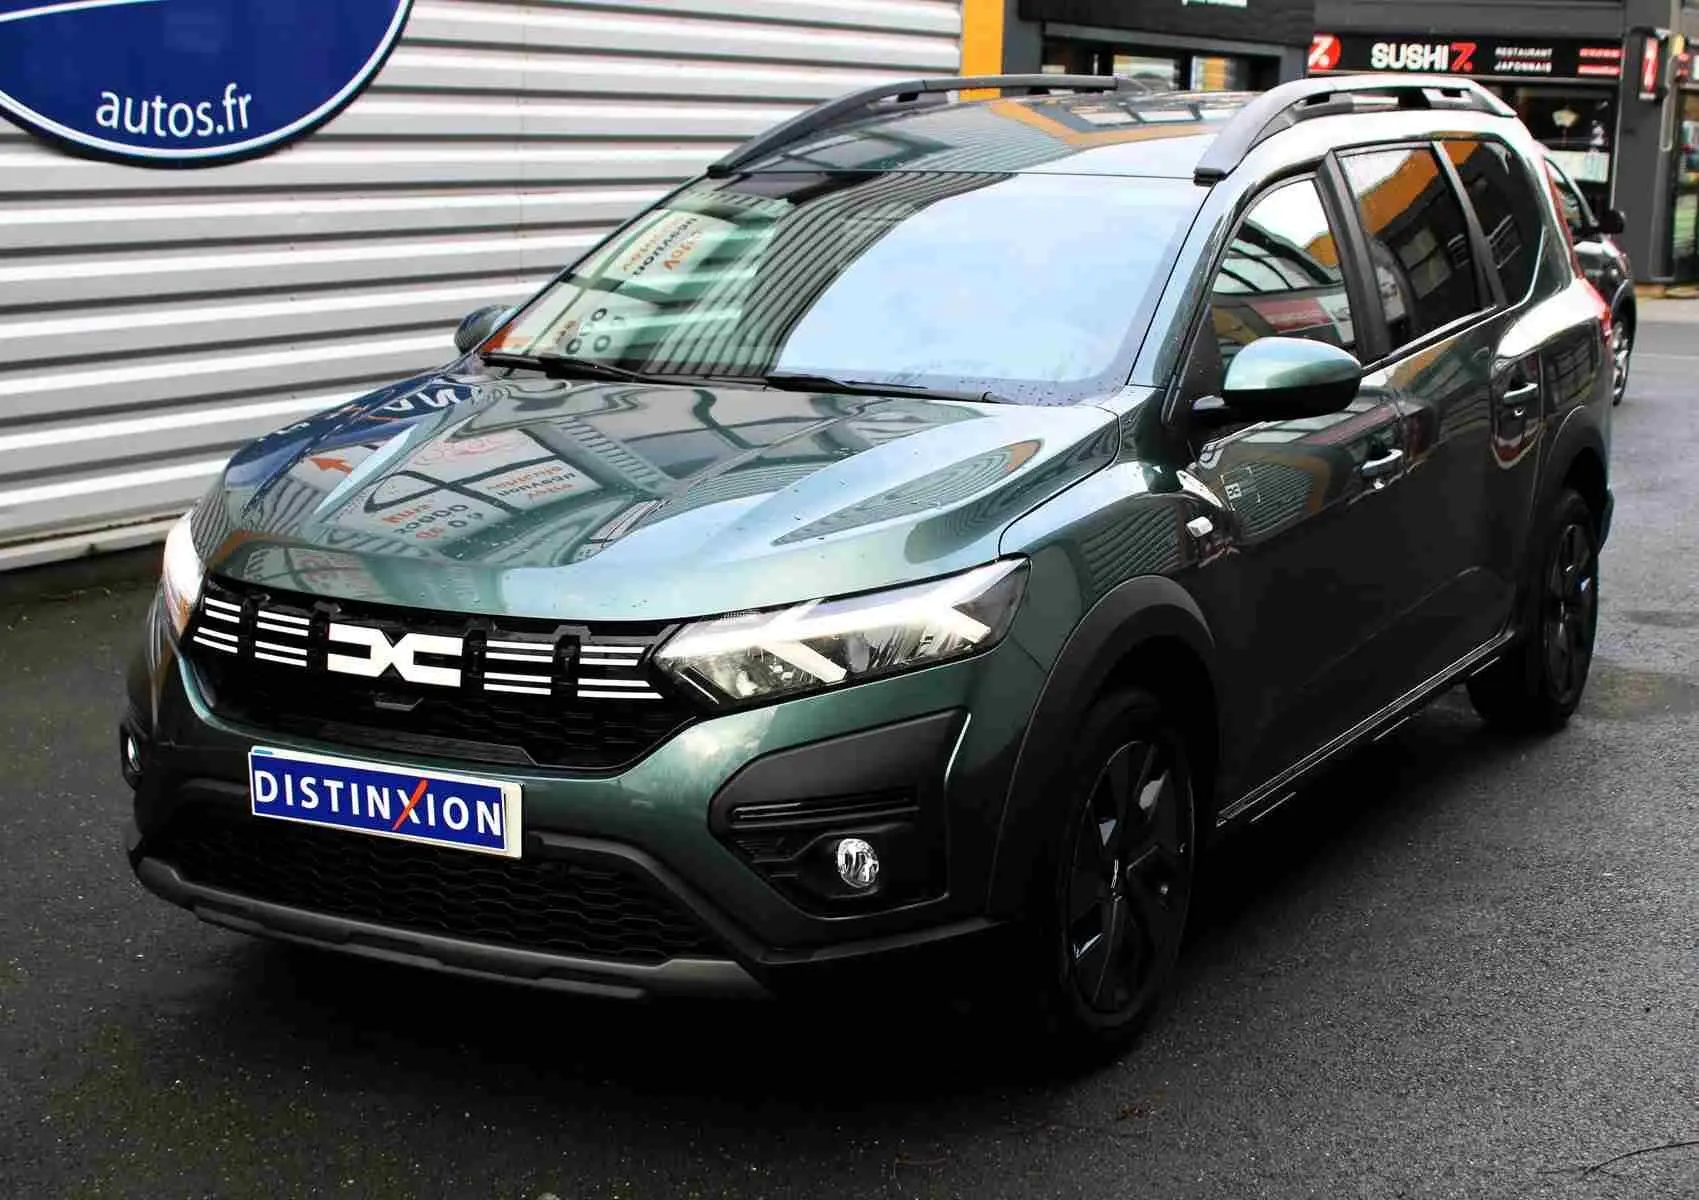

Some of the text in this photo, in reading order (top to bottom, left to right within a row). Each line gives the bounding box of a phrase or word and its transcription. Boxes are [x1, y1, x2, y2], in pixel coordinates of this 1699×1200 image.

[1495, 47, 1552, 57] RESTAURANT
[95, 82, 253, 138] autos.fr
[254, 770, 502, 837] DISTINXION
